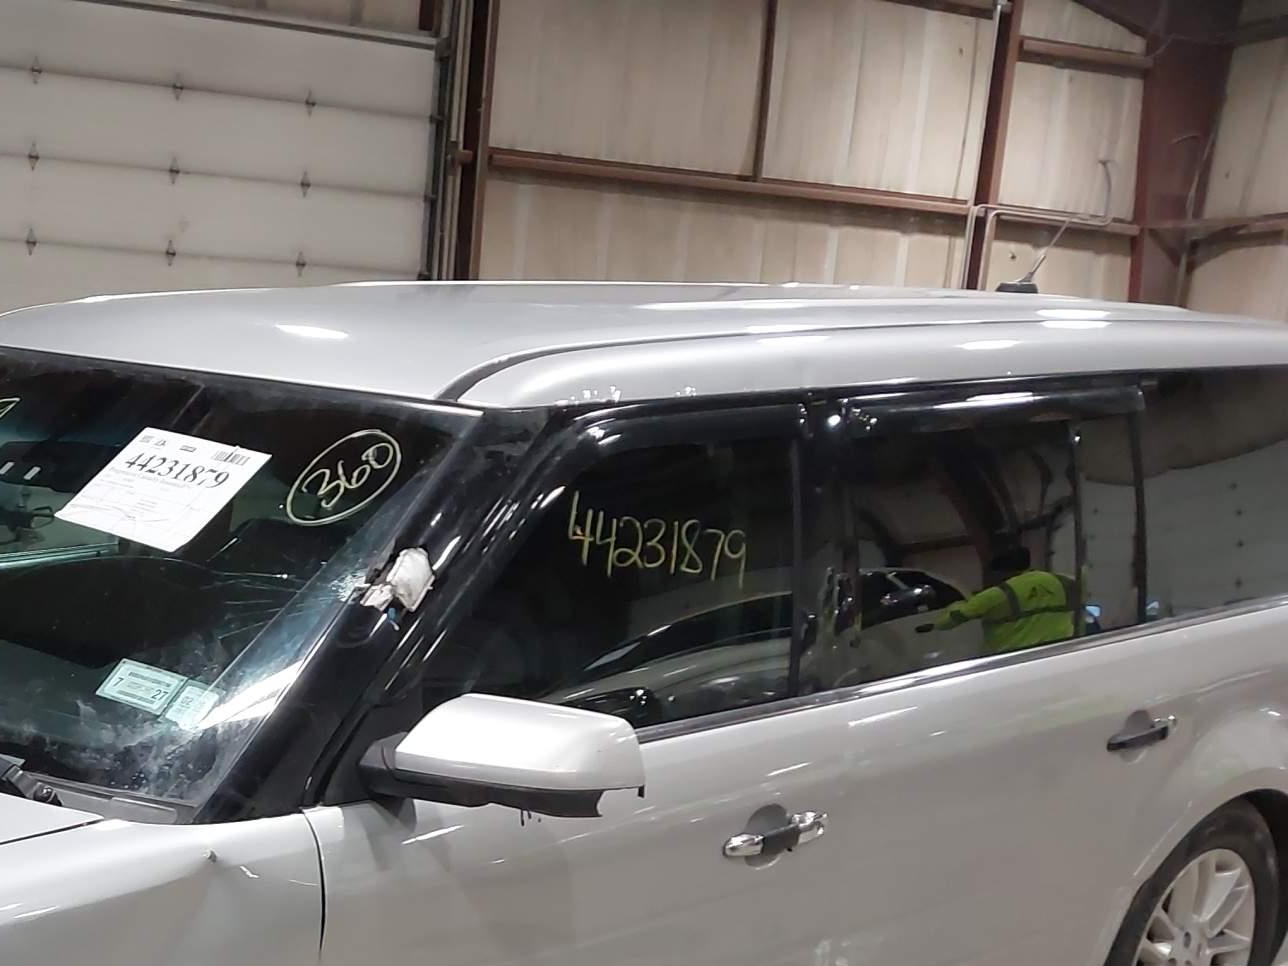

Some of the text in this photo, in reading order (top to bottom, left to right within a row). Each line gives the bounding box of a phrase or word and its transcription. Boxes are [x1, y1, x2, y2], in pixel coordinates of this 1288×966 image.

[125, 453, 230, 489] 44231879
[301, 442, 395, 508] 360
[568, 490, 747, 589] 44231879
[113, 676, 125, 688] 7
[150, 688, 169, 702] 27
